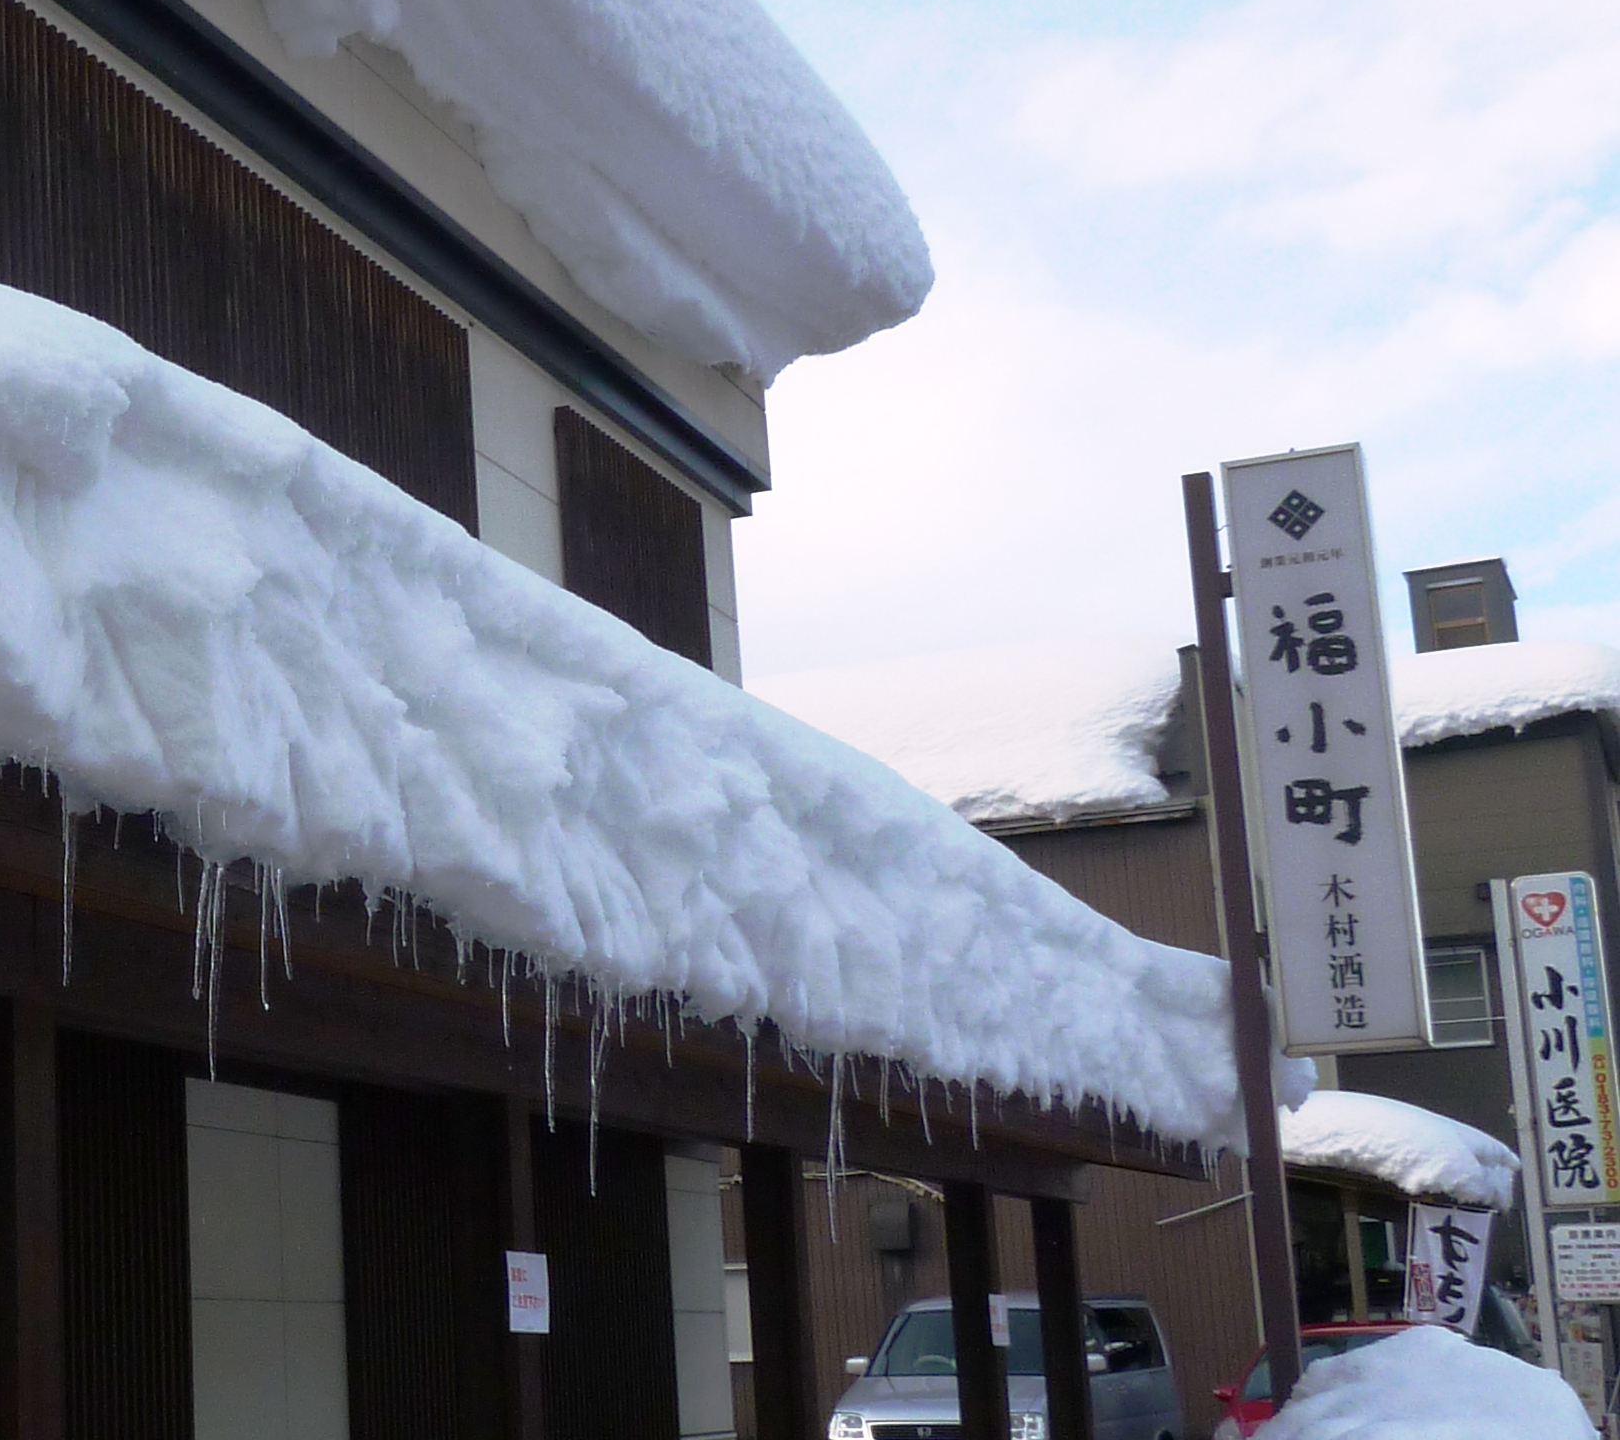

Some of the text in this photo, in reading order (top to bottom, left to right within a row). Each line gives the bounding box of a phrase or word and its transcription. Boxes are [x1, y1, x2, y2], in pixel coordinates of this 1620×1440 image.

[1269, 592, 1370, 845] 福小町
[1319, 873, 1369, 1029] 木村酒造
[1521, 925, 1575, 939] OGAWA
[1531, 966, 1600, 1188] 小川医院
